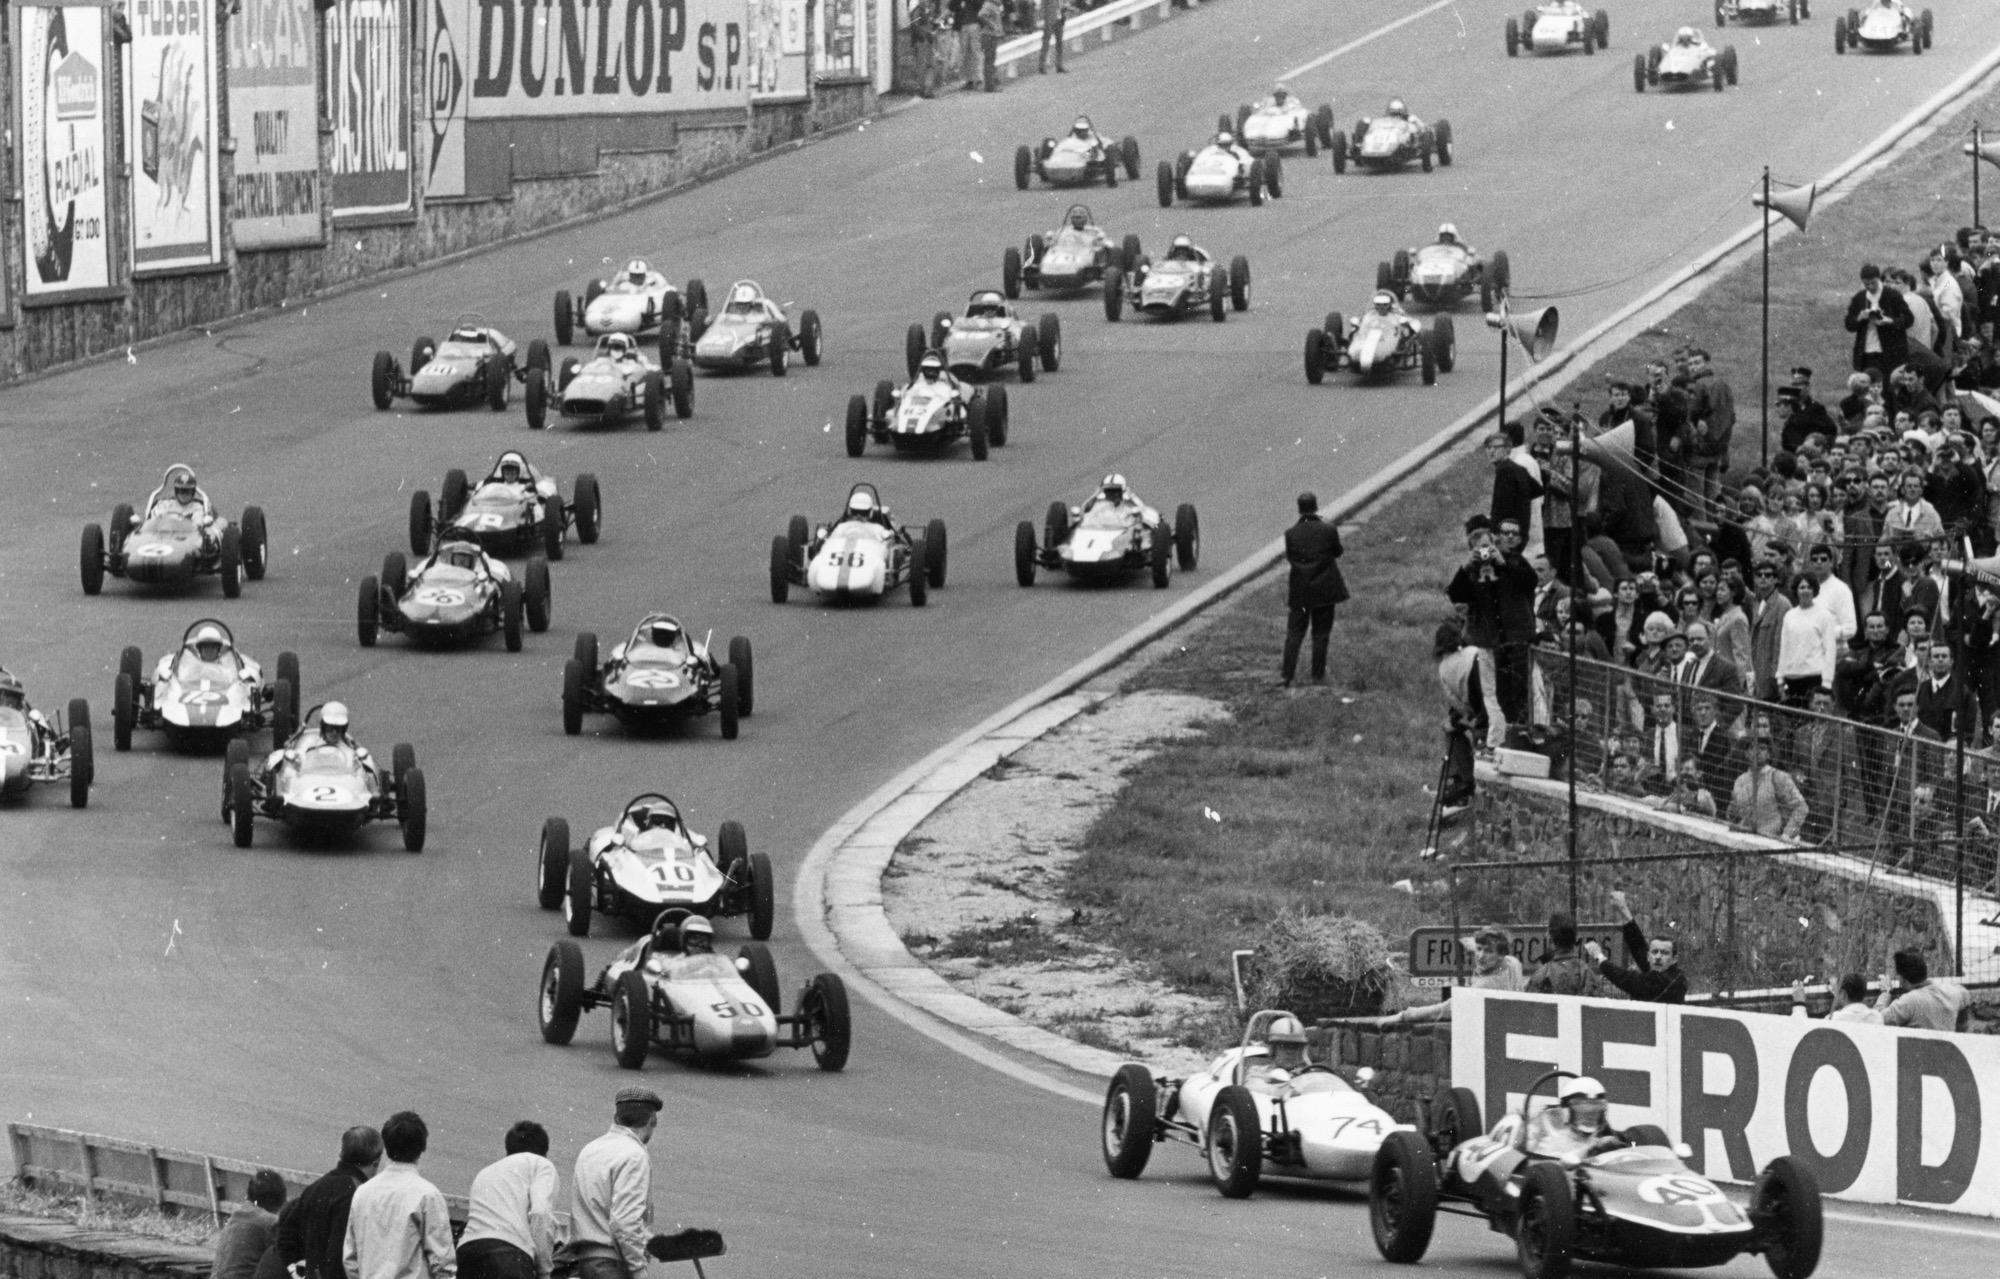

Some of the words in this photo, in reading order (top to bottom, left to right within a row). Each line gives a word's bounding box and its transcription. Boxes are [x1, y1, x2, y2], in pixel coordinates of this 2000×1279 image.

[137, 1, 200, 36] TUDOR
[229, 0, 309, 69] LUCAS
[473, 0, 687, 98] DUNLOP
[326, 0, 407, 175] CASTROL
[55, 145, 99, 204] RADIAL
[828, 551, 865, 568] 56
[312, 786, 337, 802] 2
[652, 866, 695, 881] 10
[710, 1001, 765, 1018] 50
[1330, 1116, 1383, 1139] 74
[1656, 1179, 1717, 1205] 40
